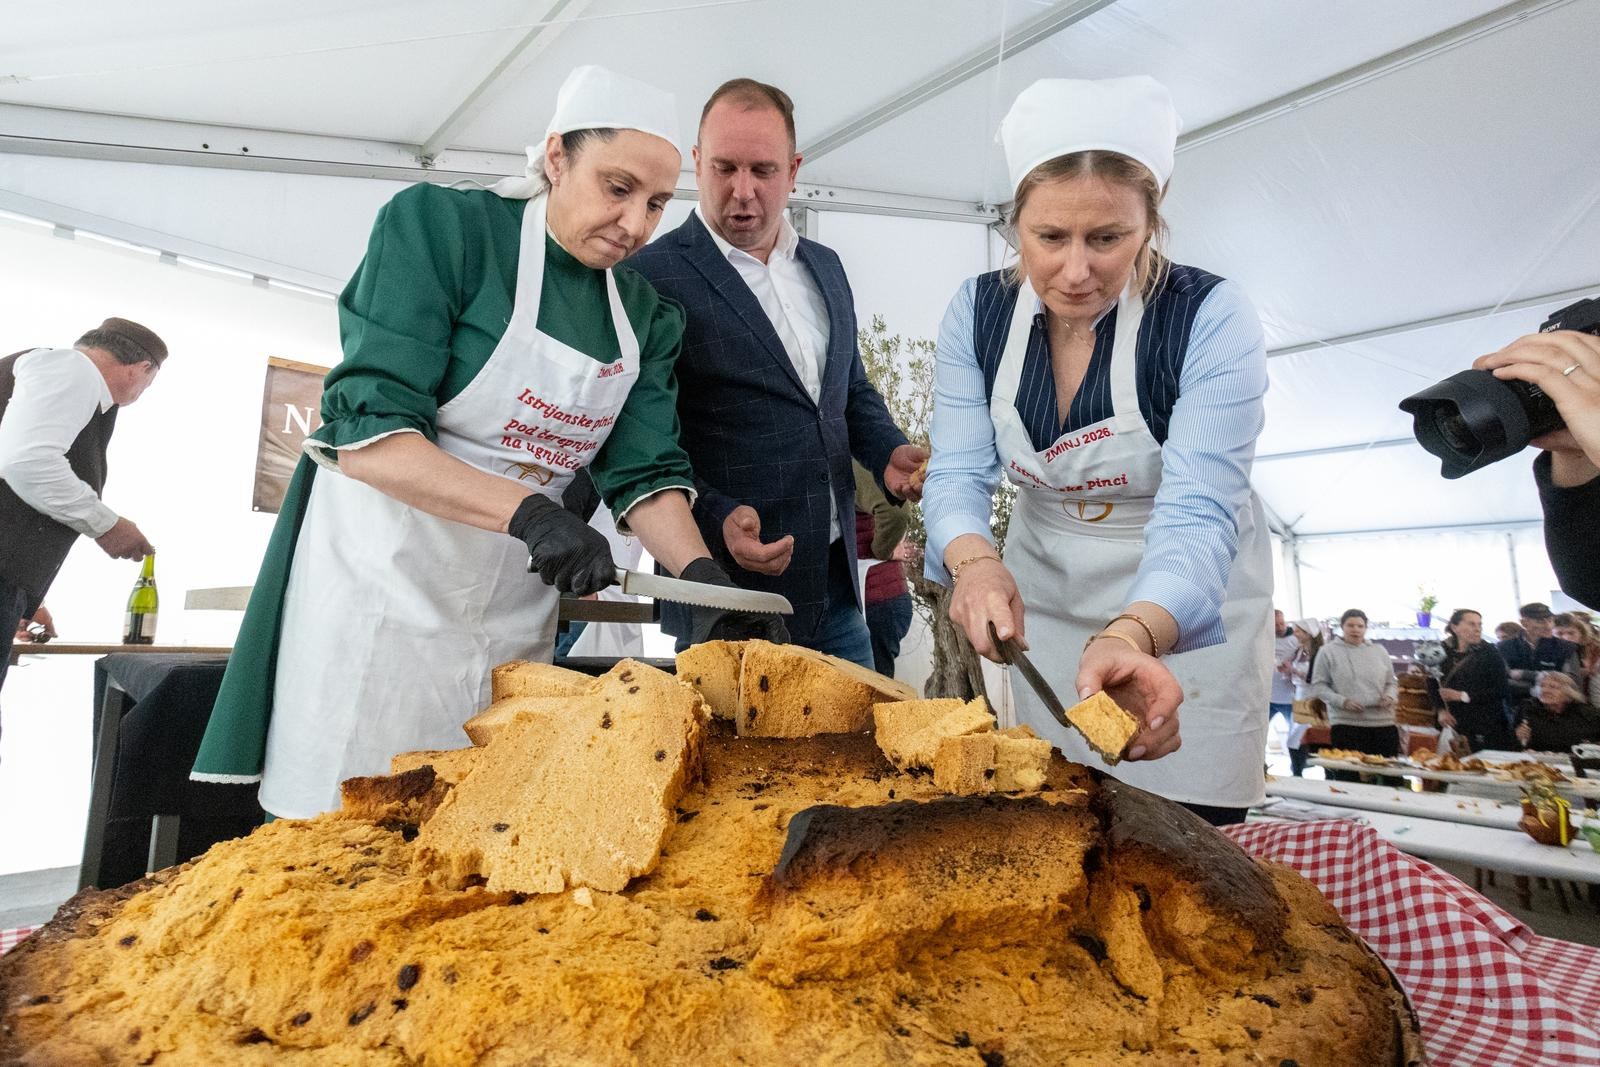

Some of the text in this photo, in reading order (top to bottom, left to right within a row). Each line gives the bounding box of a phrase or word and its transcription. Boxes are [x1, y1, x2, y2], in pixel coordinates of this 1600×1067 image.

[517, 388, 593, 428] Istrijanske
[504, 418, 540, 436] pod
[1082, 427, 1115, 444] 2026.
[501, 435, 522, 449] na
